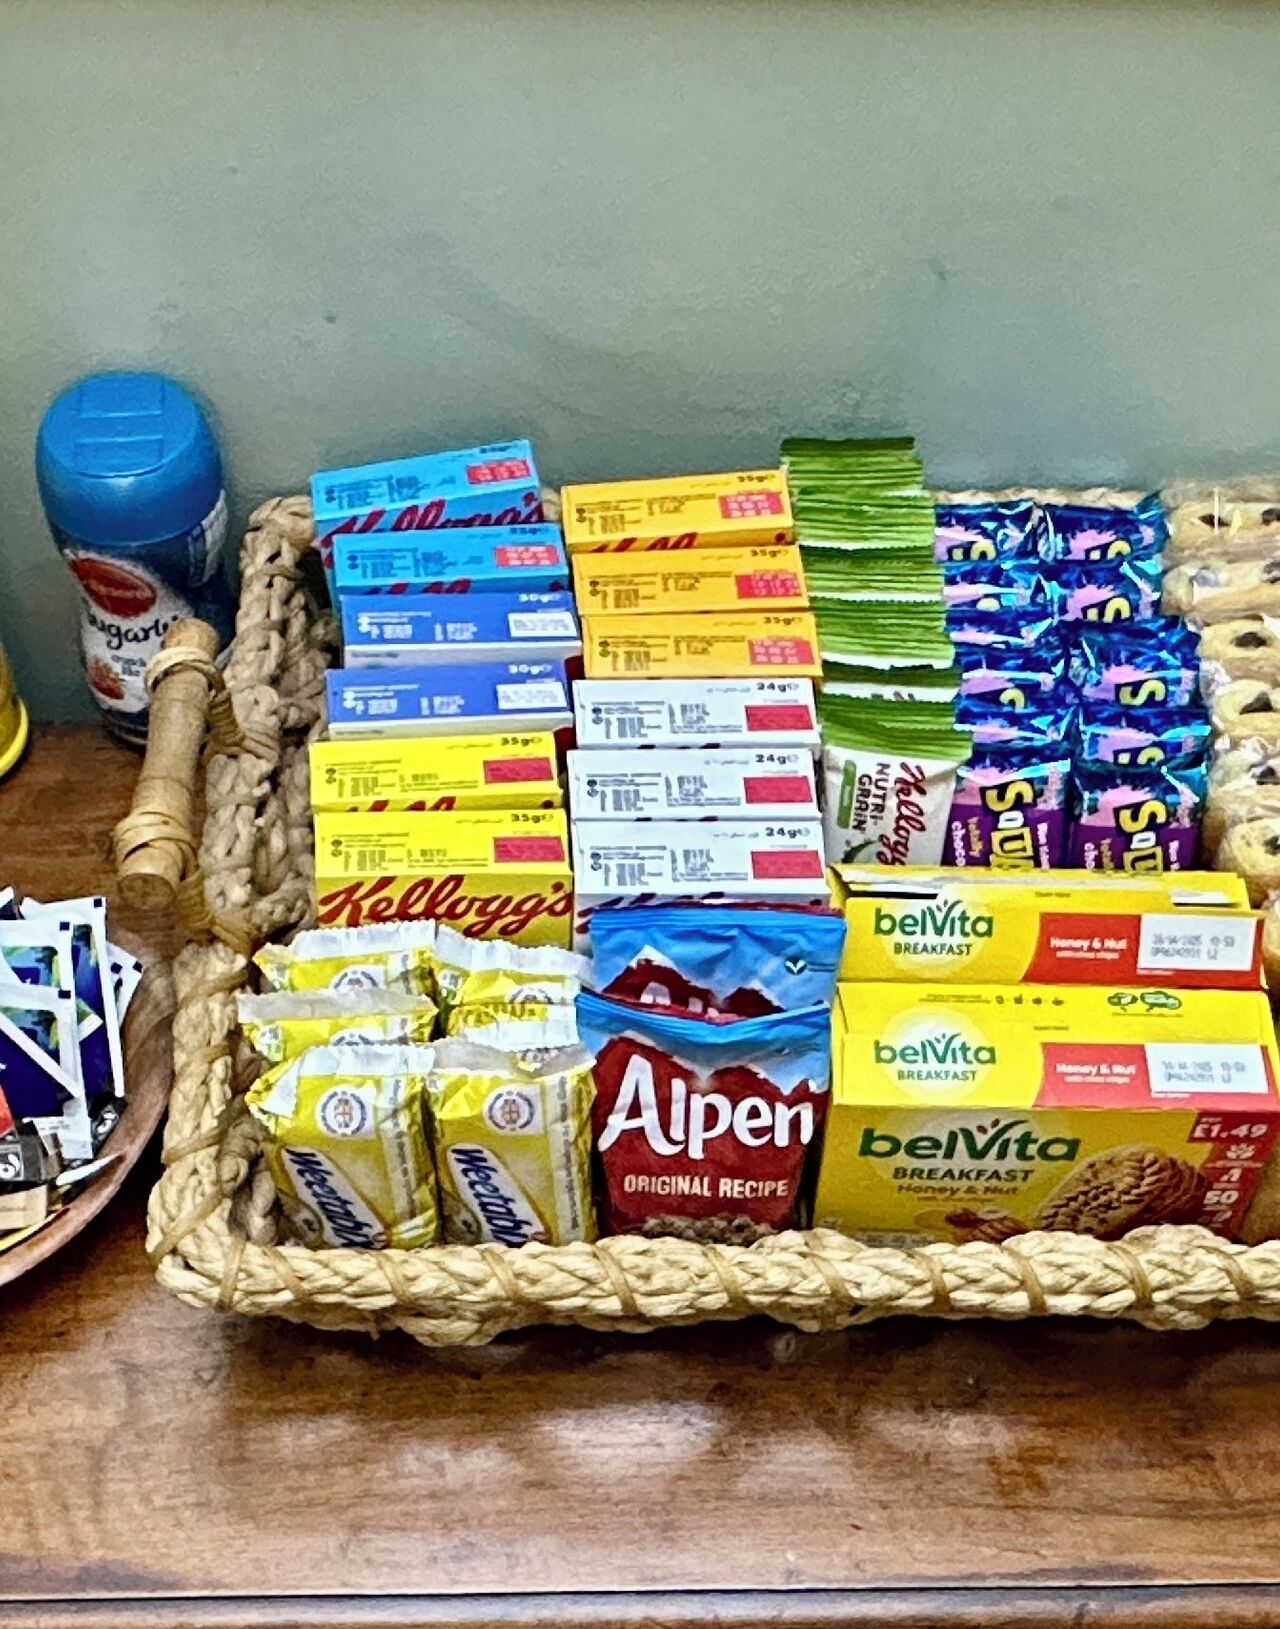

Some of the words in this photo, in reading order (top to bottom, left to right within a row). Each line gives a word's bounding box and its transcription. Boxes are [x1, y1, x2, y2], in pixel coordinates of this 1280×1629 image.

[316, 874, 573, 938] Kellogg's
[873, 900, 994, 938] belVita
[893, 942, 973, 956] BREAKFAST
[1049, 936, 1091, 953] Honey
[1093, 937, 1104, 951] &
[1105, 937, 1128, 951] Nut
[874, 1032, 997, 1065] belVita
[897, 1068, 977, 1081] BREAKFAST
[598, 1054, 814, 1161] Alpen
[858, 1119, 1081, 1162] belVita
[1192, 1123, 1269, 1140] £1.49
[892, 1166, 1036, 1183] BREAKFAST
[624, 1174, 712, 1198] ORIGINAL
[719, 1178, 789, 1200] RECIPE
[898, 1183, 960, 1197] Honey
[983, 1184, 1018, 1196] Nut
